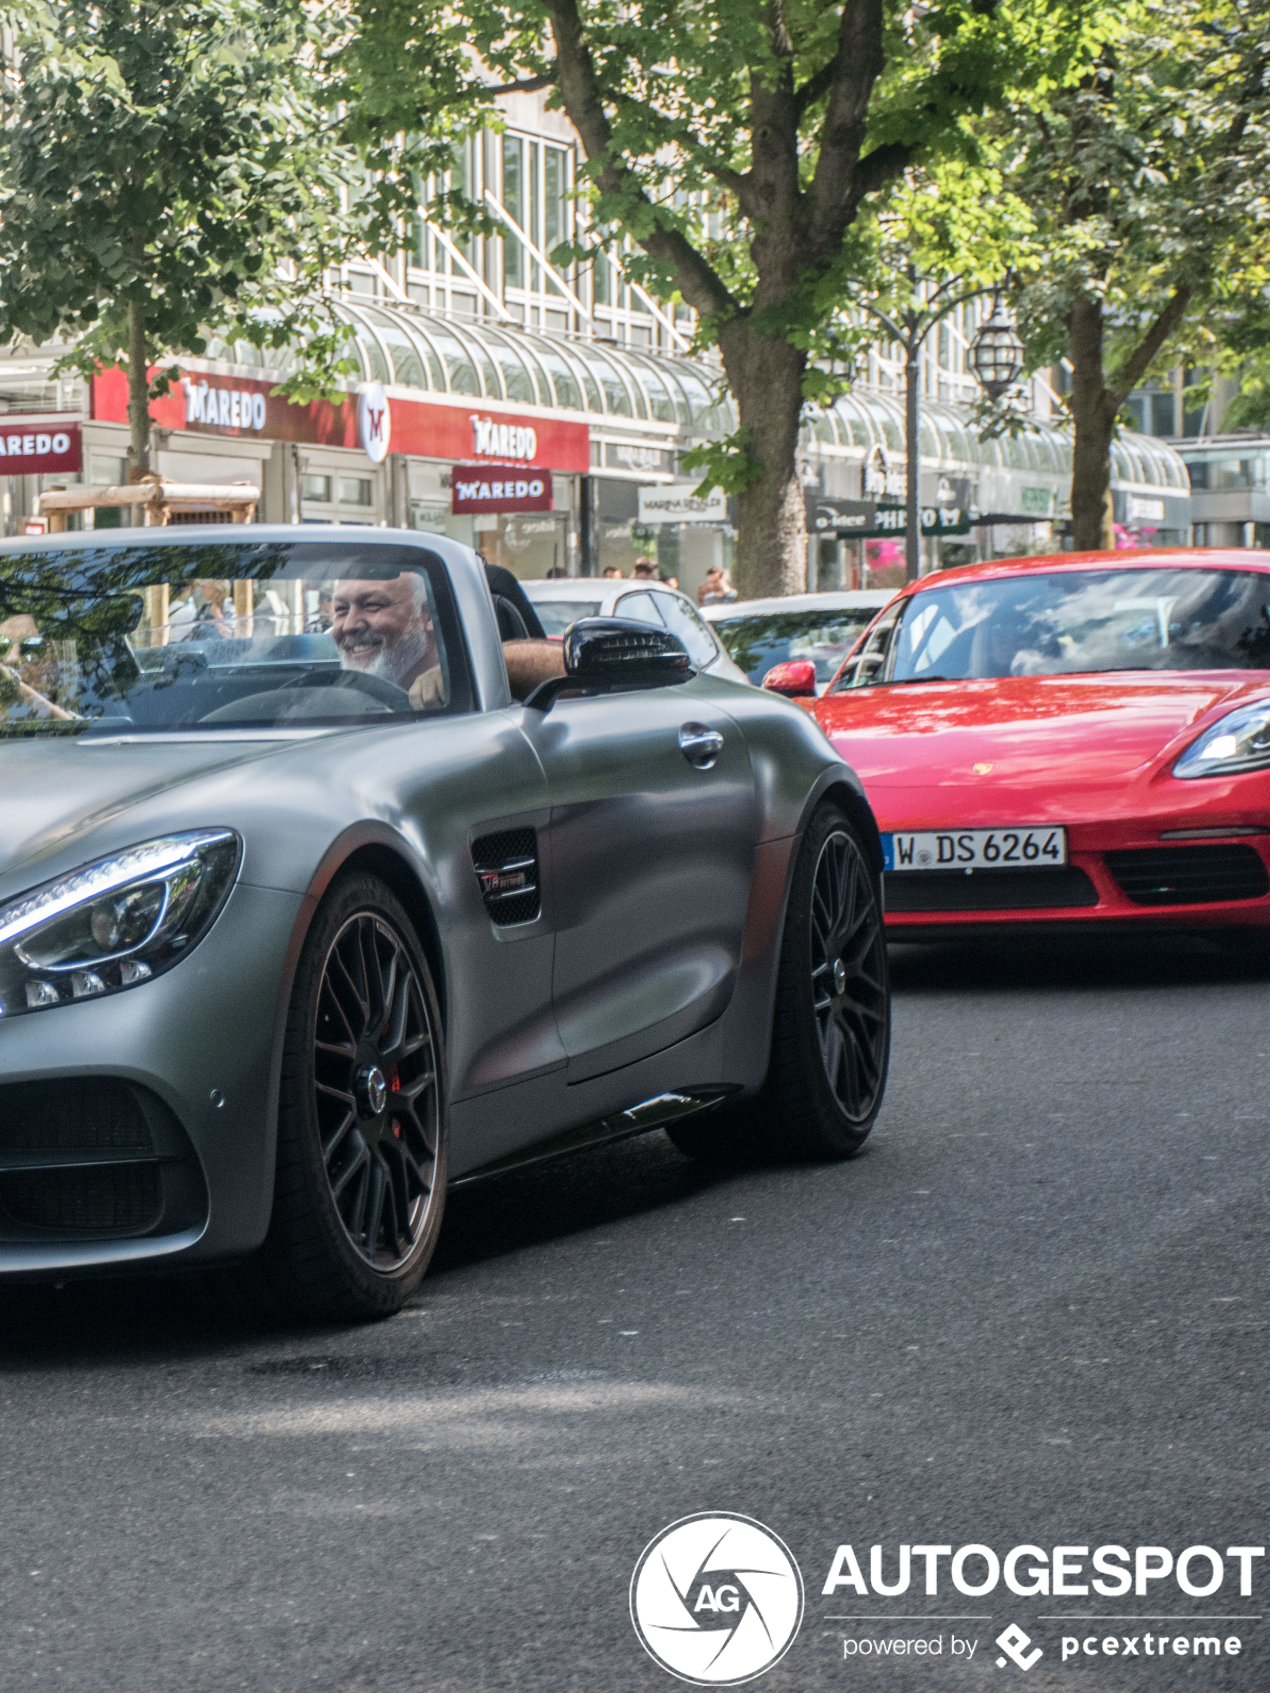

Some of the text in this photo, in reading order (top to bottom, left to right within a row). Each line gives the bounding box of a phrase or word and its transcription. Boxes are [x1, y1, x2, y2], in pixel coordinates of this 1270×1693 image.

[179, 377, 267, 430] MAREDO
[469, 414, 537, 461] MAREDO
[455, 479, 545, 501] MAREDO
[897, 832, 1059, 864] W DS 6264
